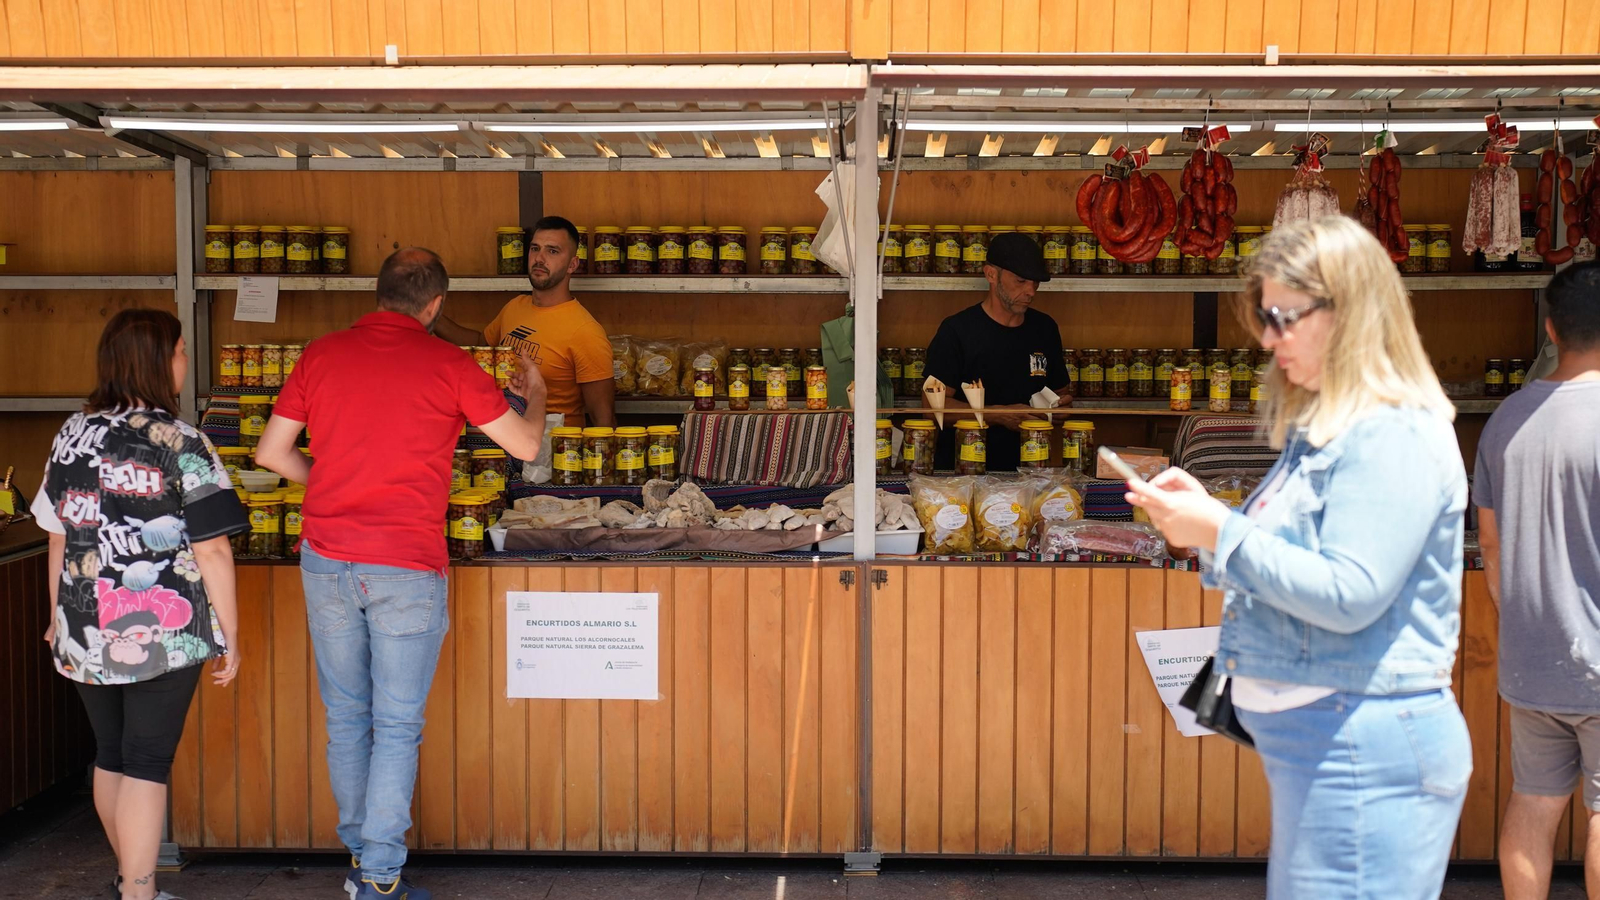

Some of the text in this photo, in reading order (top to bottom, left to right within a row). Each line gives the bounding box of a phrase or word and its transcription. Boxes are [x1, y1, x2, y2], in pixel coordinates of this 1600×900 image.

[526, 619, 637, 628] ENCURTIDOS ALMARIO S.L
[1158, 655, 1210, 665] ENCURTIDO
